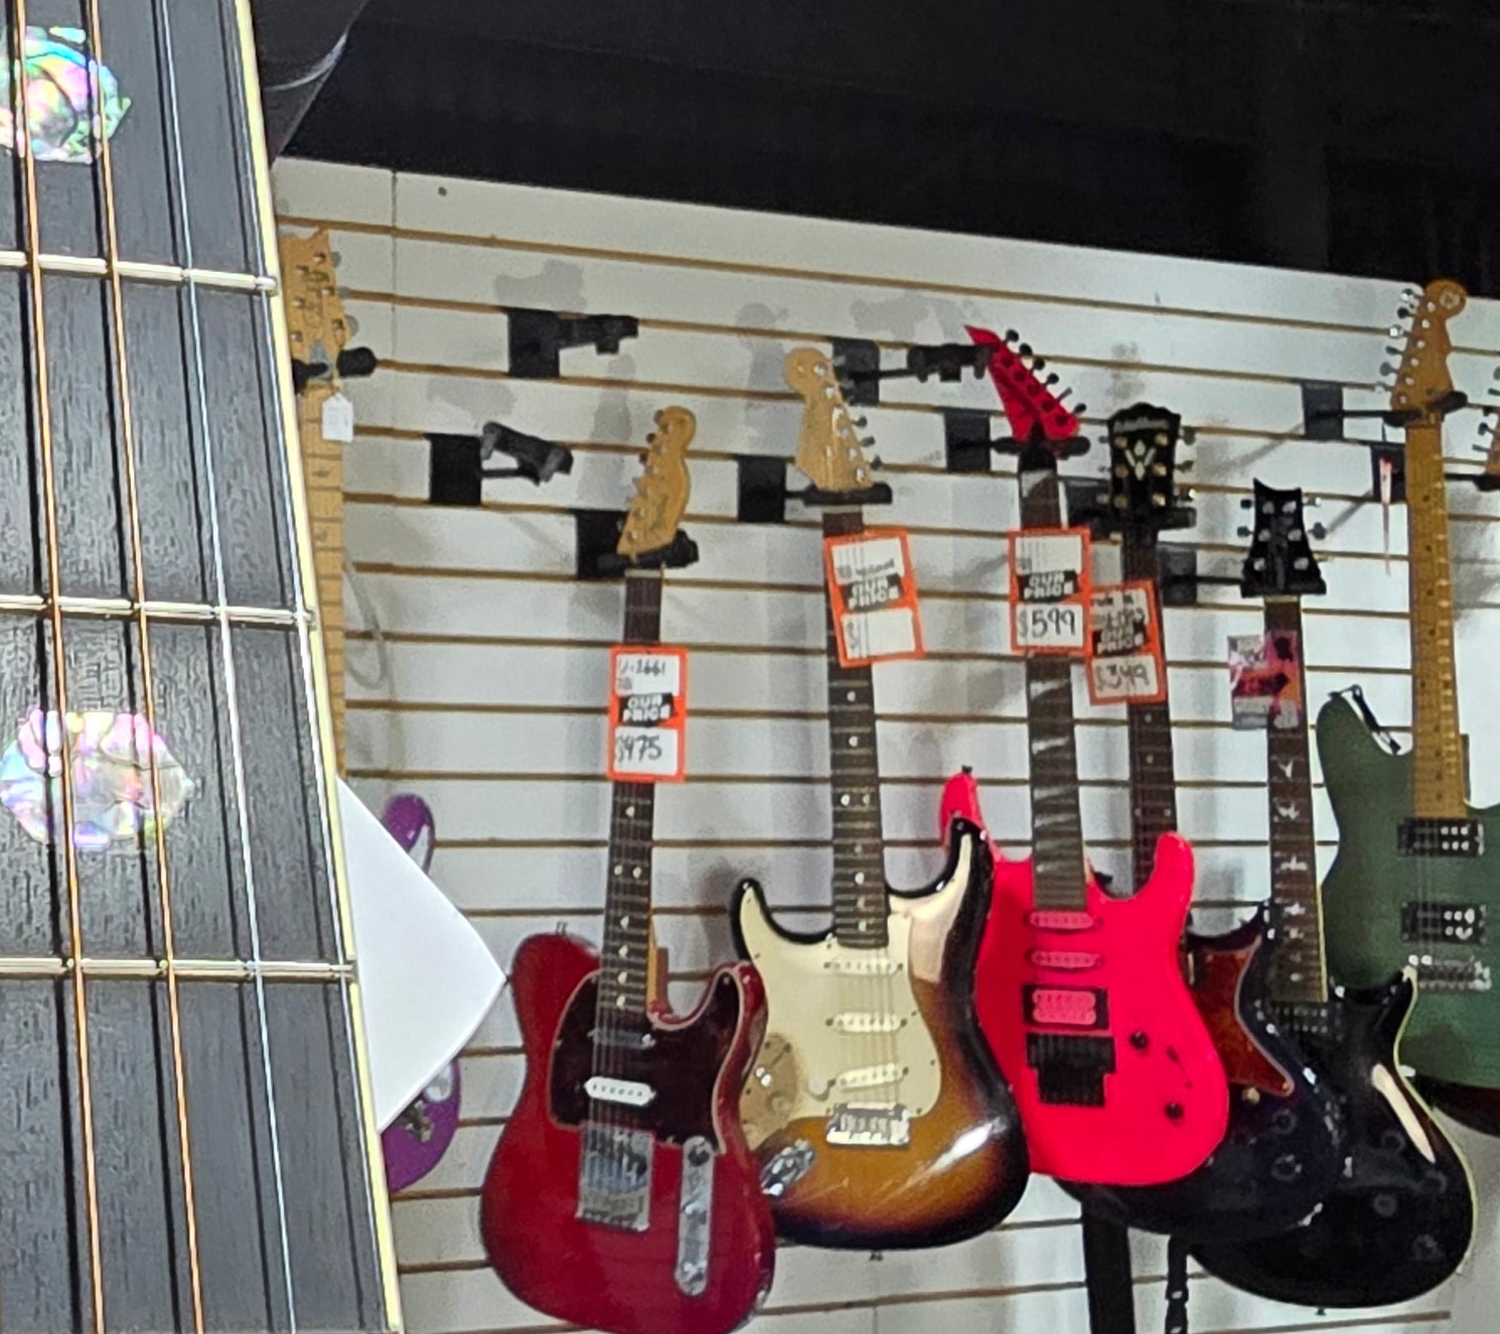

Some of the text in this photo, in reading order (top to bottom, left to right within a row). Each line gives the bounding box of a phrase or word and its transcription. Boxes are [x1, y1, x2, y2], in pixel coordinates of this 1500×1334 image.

[1023, 581, 1074, 599] PRICE
[1017, 607, 1076, 639] $599
[627, 693, 663, 709] OUR
[622, 704, 671, 722] PRICE
